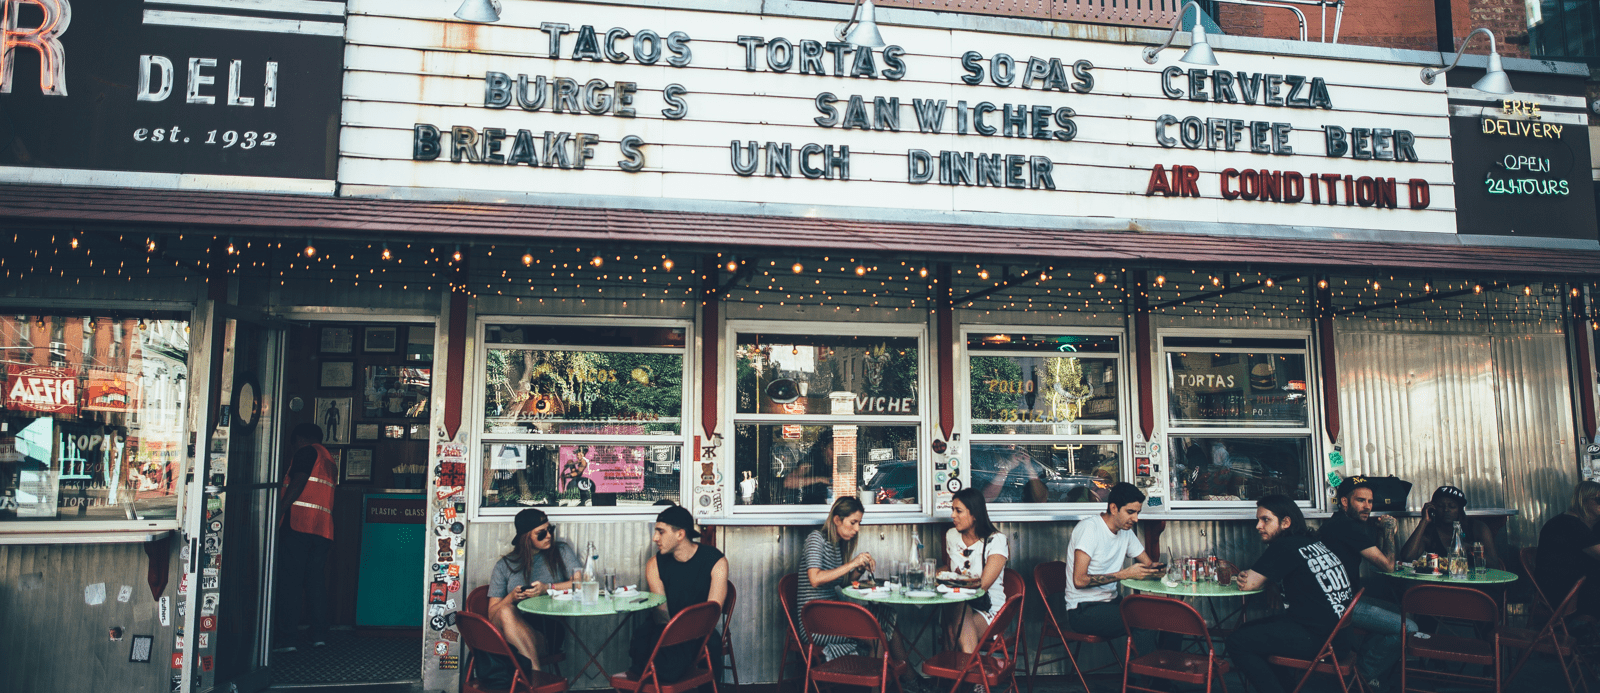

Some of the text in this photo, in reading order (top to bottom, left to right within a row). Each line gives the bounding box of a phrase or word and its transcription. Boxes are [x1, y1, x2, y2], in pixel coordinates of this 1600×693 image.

[540, 22, 1333, 110] TACOS TORTAS SOPAS CERVEZA
[137, 54, 278, 108] DELI
[1503, 99, 1541, 116] FREE
[133, 126, 278, 150] est. 1932
[1155, 114, 1293, 156] COFFEE
[1325, 125, 1419, 162] BEER
[1483, 119, 1563, 139] DELIVERY
[730, 140, 849, 181] UNCH
[908, 149, 1056, 190] DINNER
[1146, 164, 1200, 198] AIR
[1504, 154, 1550, 173] OPEN
[1508, 178, 1570, 195] HOURS
[989, 379, 1035, 394] POLLO
[1178, 374, 1235, 389] TORTAS
[855, 396, 913, 413] VICHE
[371, 507, 425, 517] PLASTIC GLASS
